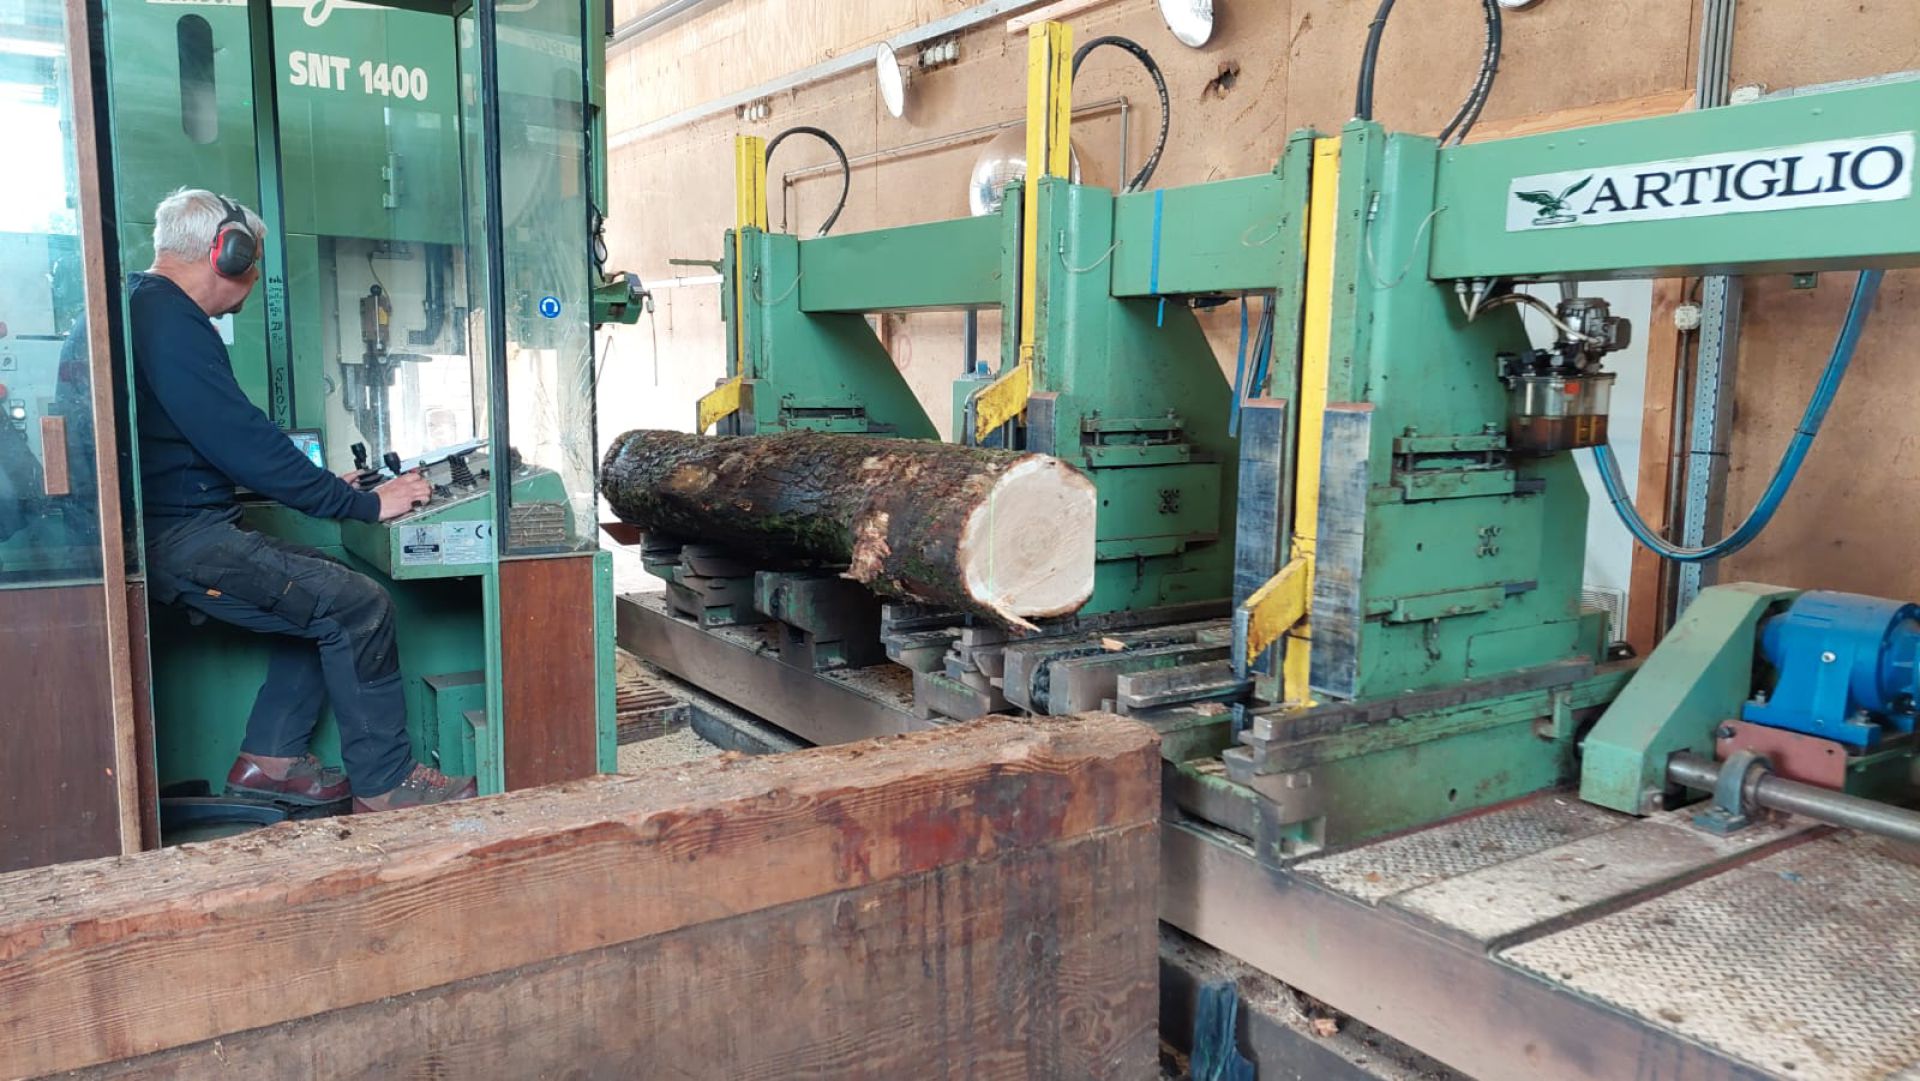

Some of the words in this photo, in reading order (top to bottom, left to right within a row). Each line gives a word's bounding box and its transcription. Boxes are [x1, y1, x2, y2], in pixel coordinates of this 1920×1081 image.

[289, 50, 351, 91] SNT
[359, 61, 429, 101] 1400
[1581, 144, 1903, 215] ARTIGLIO
